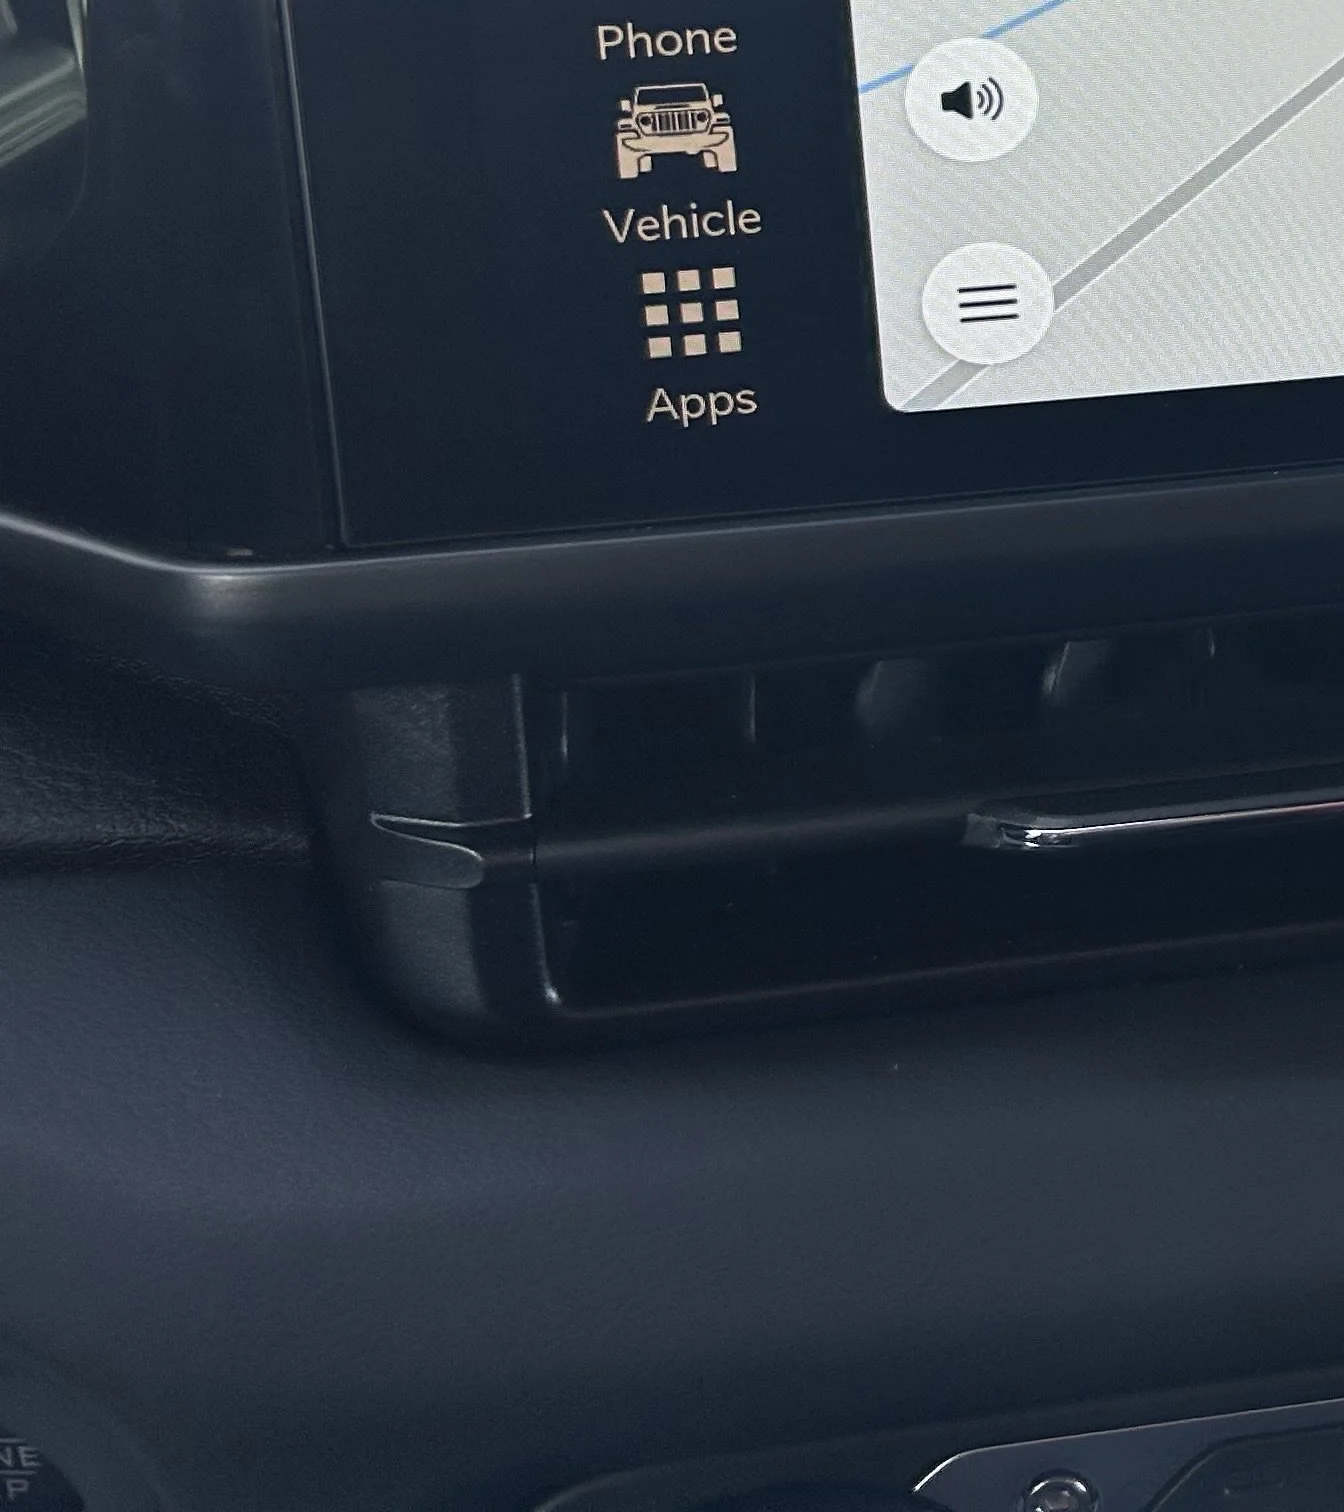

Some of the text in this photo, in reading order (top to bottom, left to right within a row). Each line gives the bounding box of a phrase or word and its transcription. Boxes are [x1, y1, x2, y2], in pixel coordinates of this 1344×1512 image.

[598, 23, 738, 60] Phone
[603, 202, 762, 242] Vehicle
[646, 386, 758, 426] Apps
